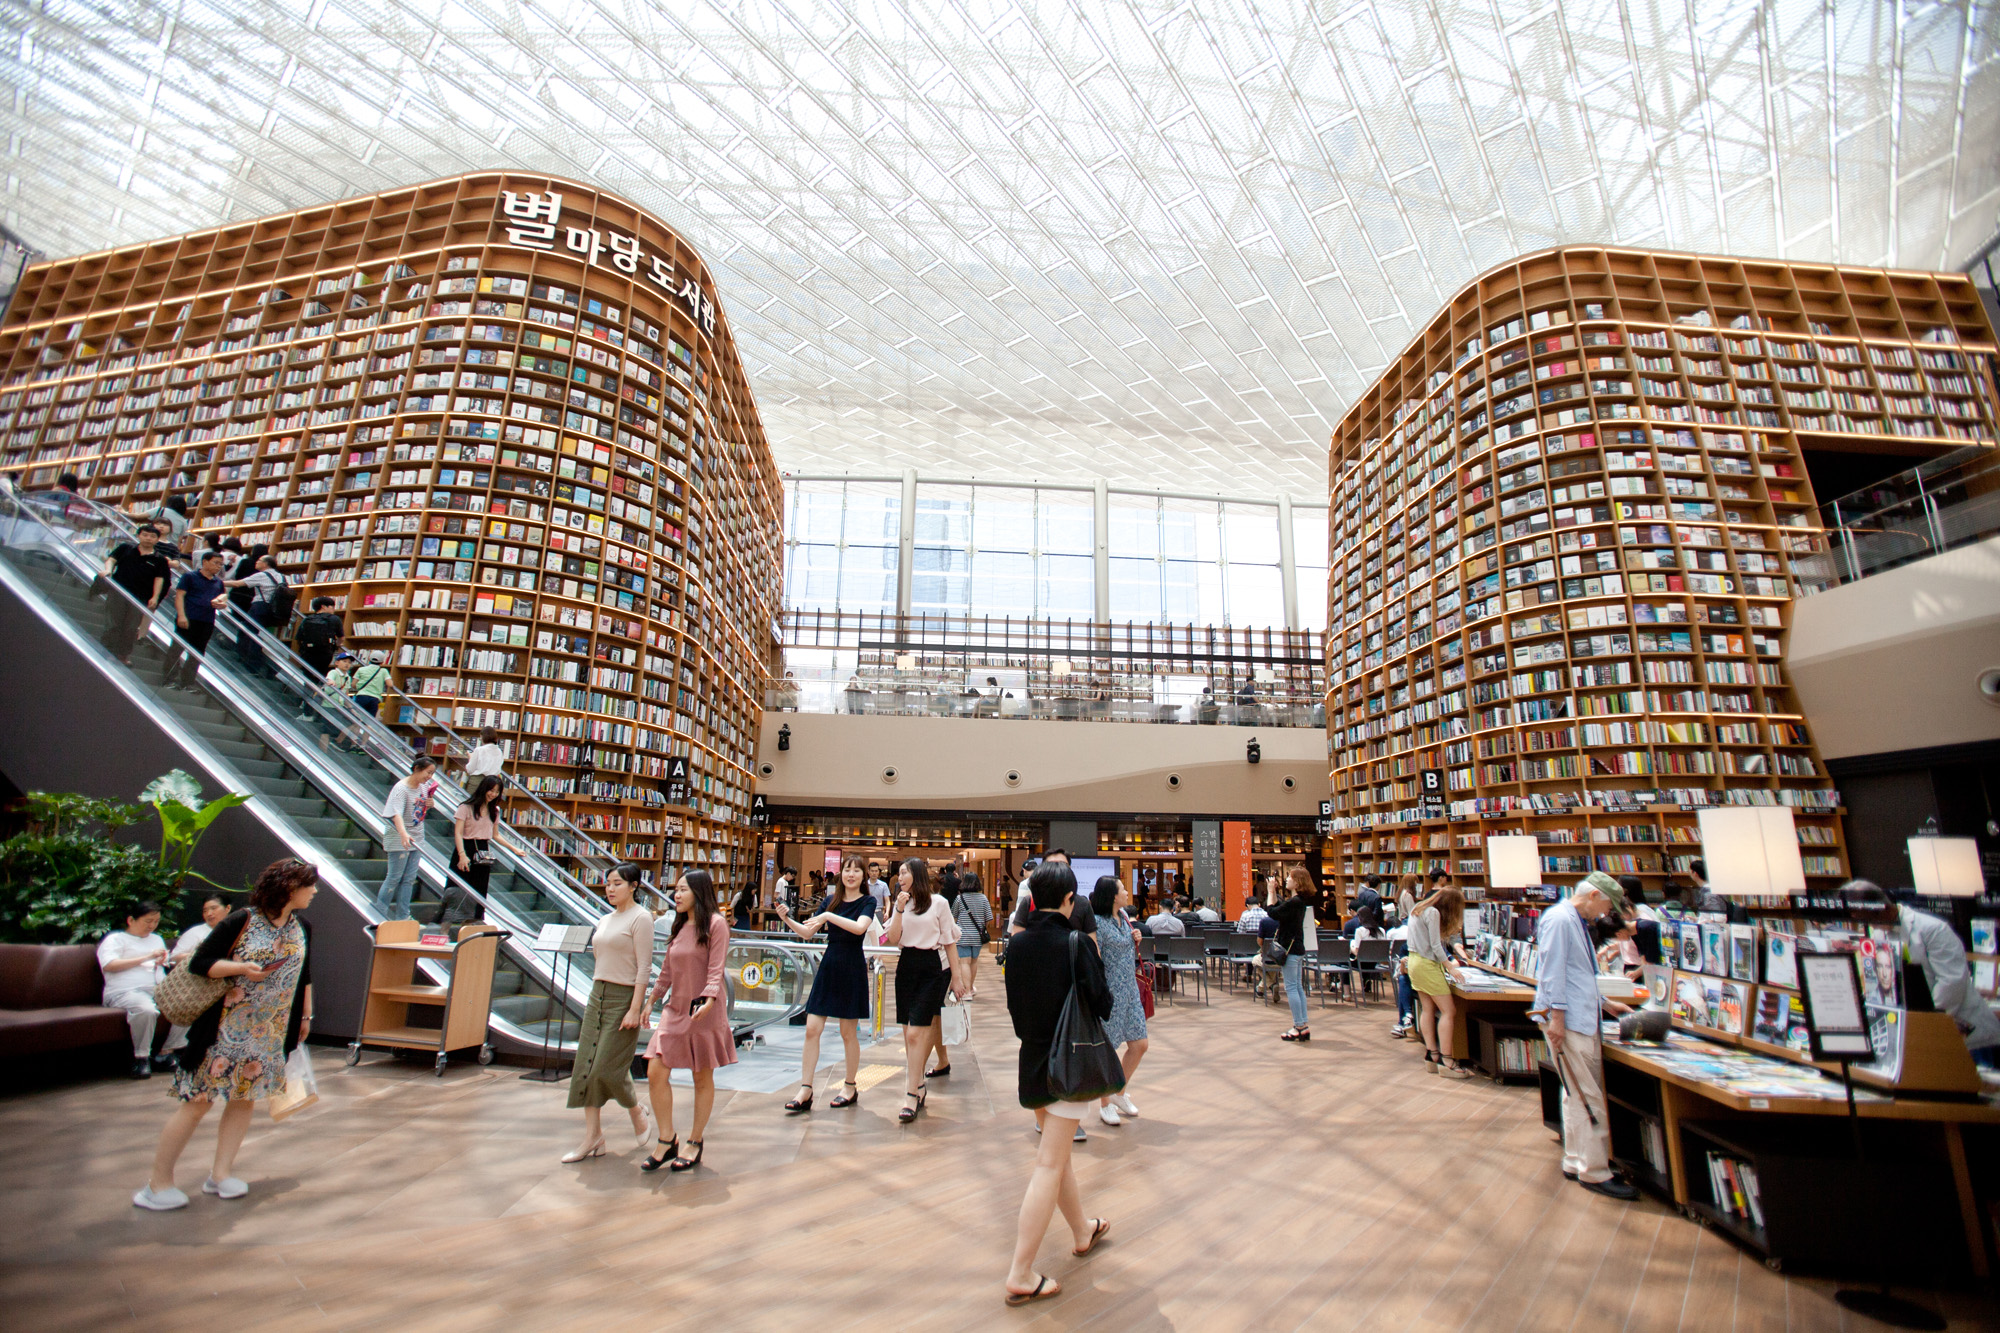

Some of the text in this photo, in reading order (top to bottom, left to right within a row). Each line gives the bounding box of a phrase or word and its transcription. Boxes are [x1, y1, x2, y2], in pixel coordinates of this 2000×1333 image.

[584, 744, 592, 762] A
[672, 760, 685, 776] A
[1425, 772, 1438, 789] B
[754, 796, 764, 807] A
[1321, 802, 1332, 815] B
[1200, 830, 1209, 867] 스타필드
[1797, 896, 1808, 908] D9
[1861, 940, 1875, 957] Q
